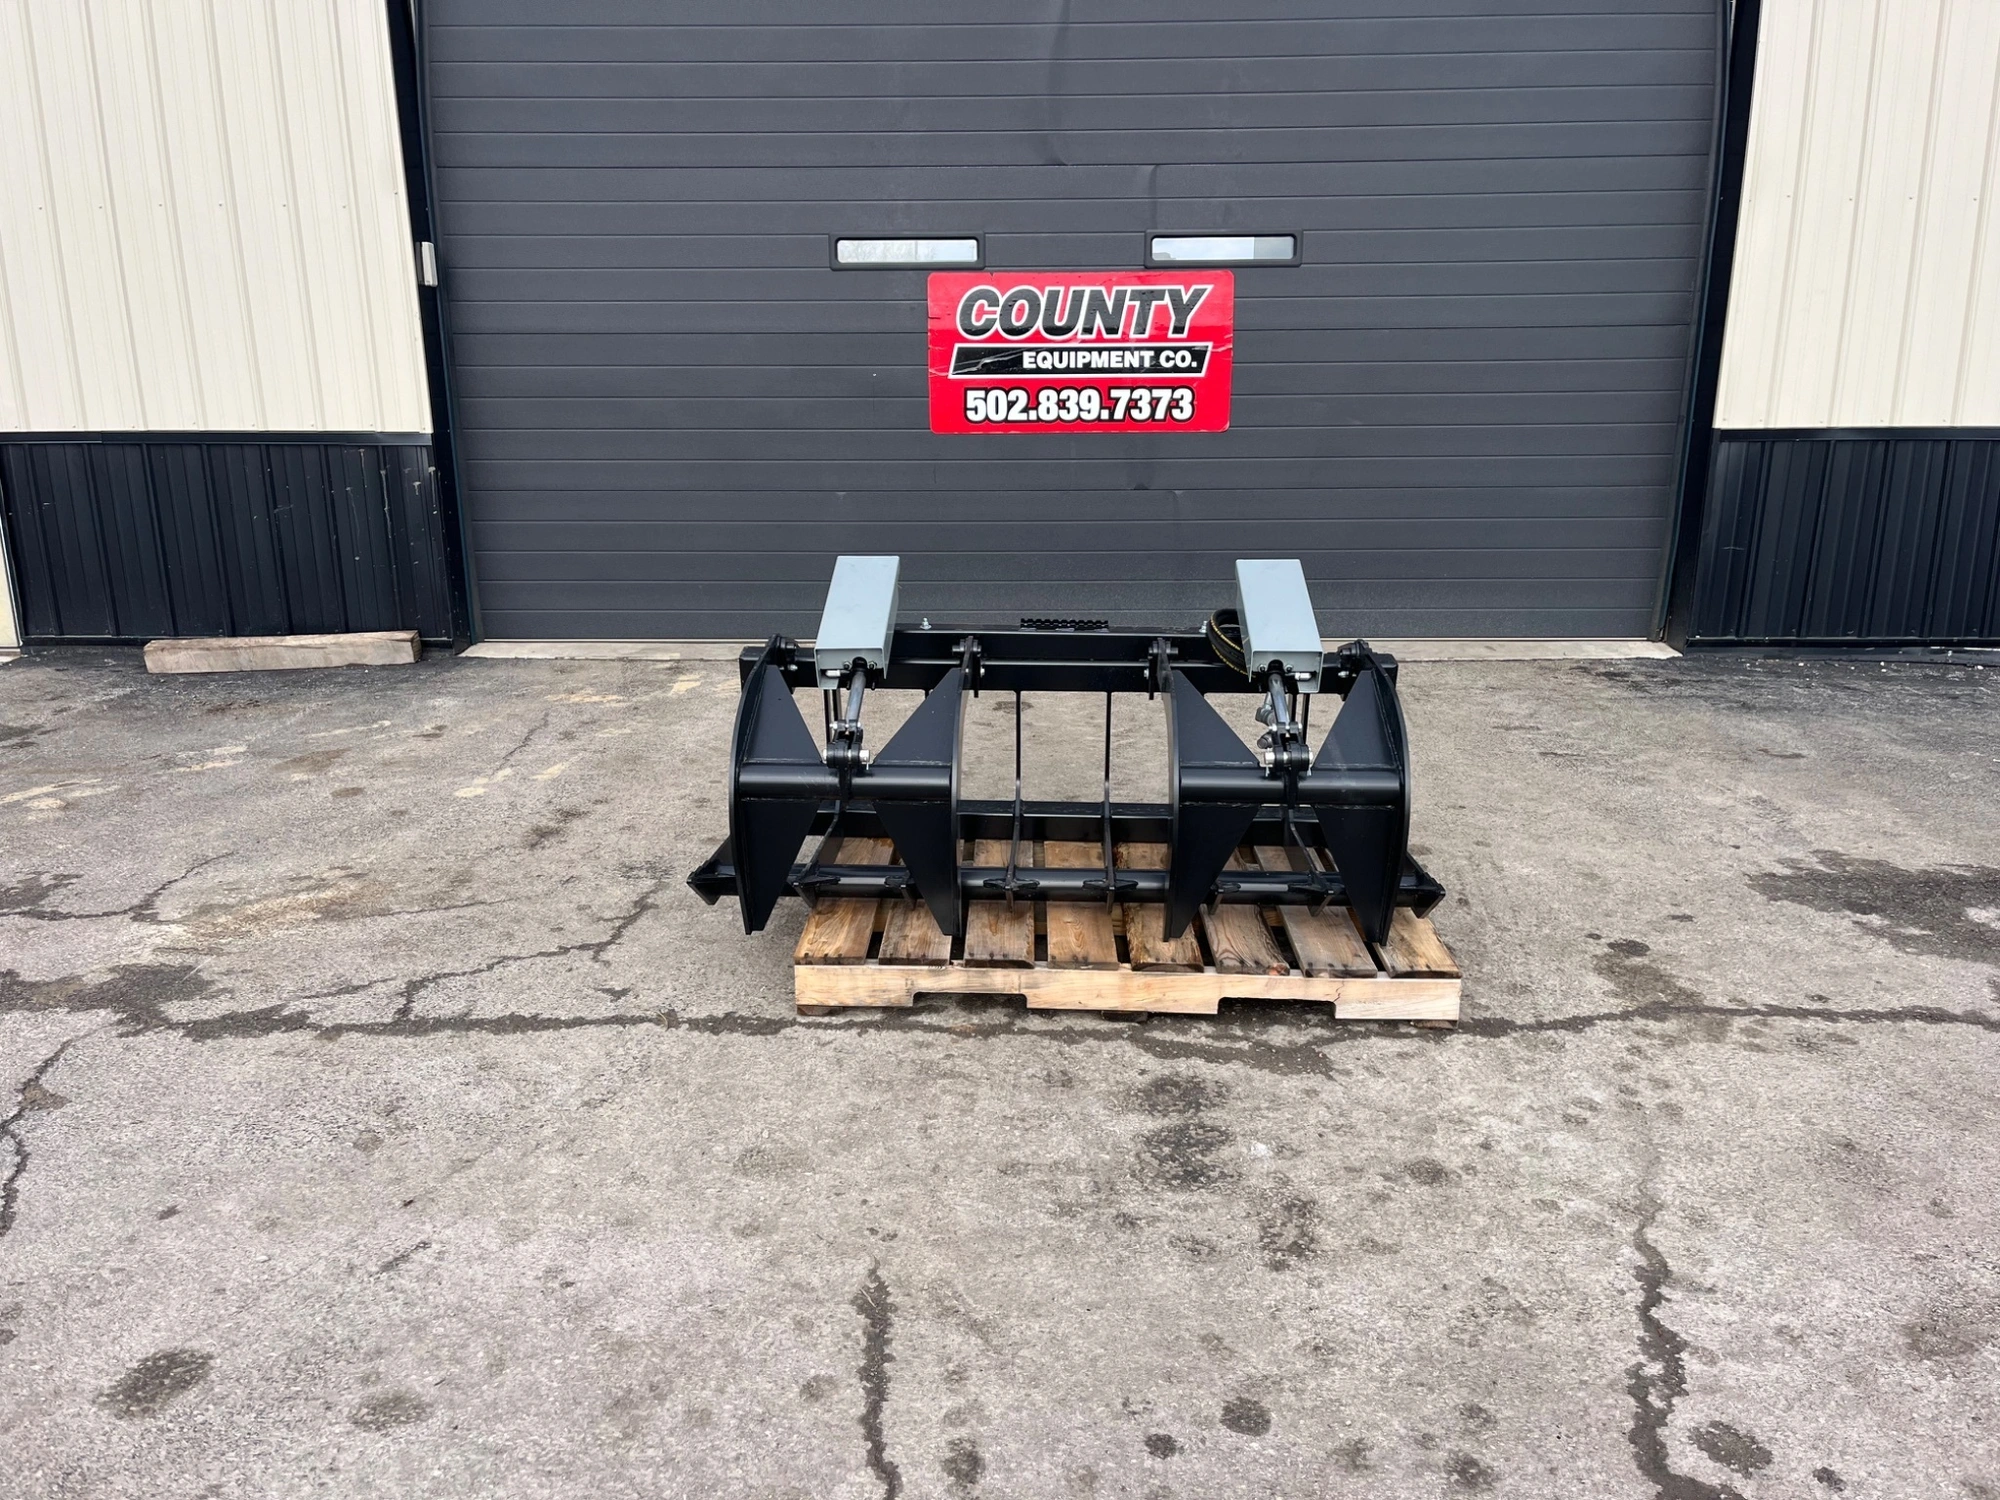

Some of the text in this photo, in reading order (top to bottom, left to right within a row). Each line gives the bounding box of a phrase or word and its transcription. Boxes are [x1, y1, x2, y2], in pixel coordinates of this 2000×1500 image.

[956, 285, 1214, 340] COUNTY
[1022, 350, 1198, 369] EQUIPMENT CO.
[965, 387, 1194, 422] 502.839.7373
